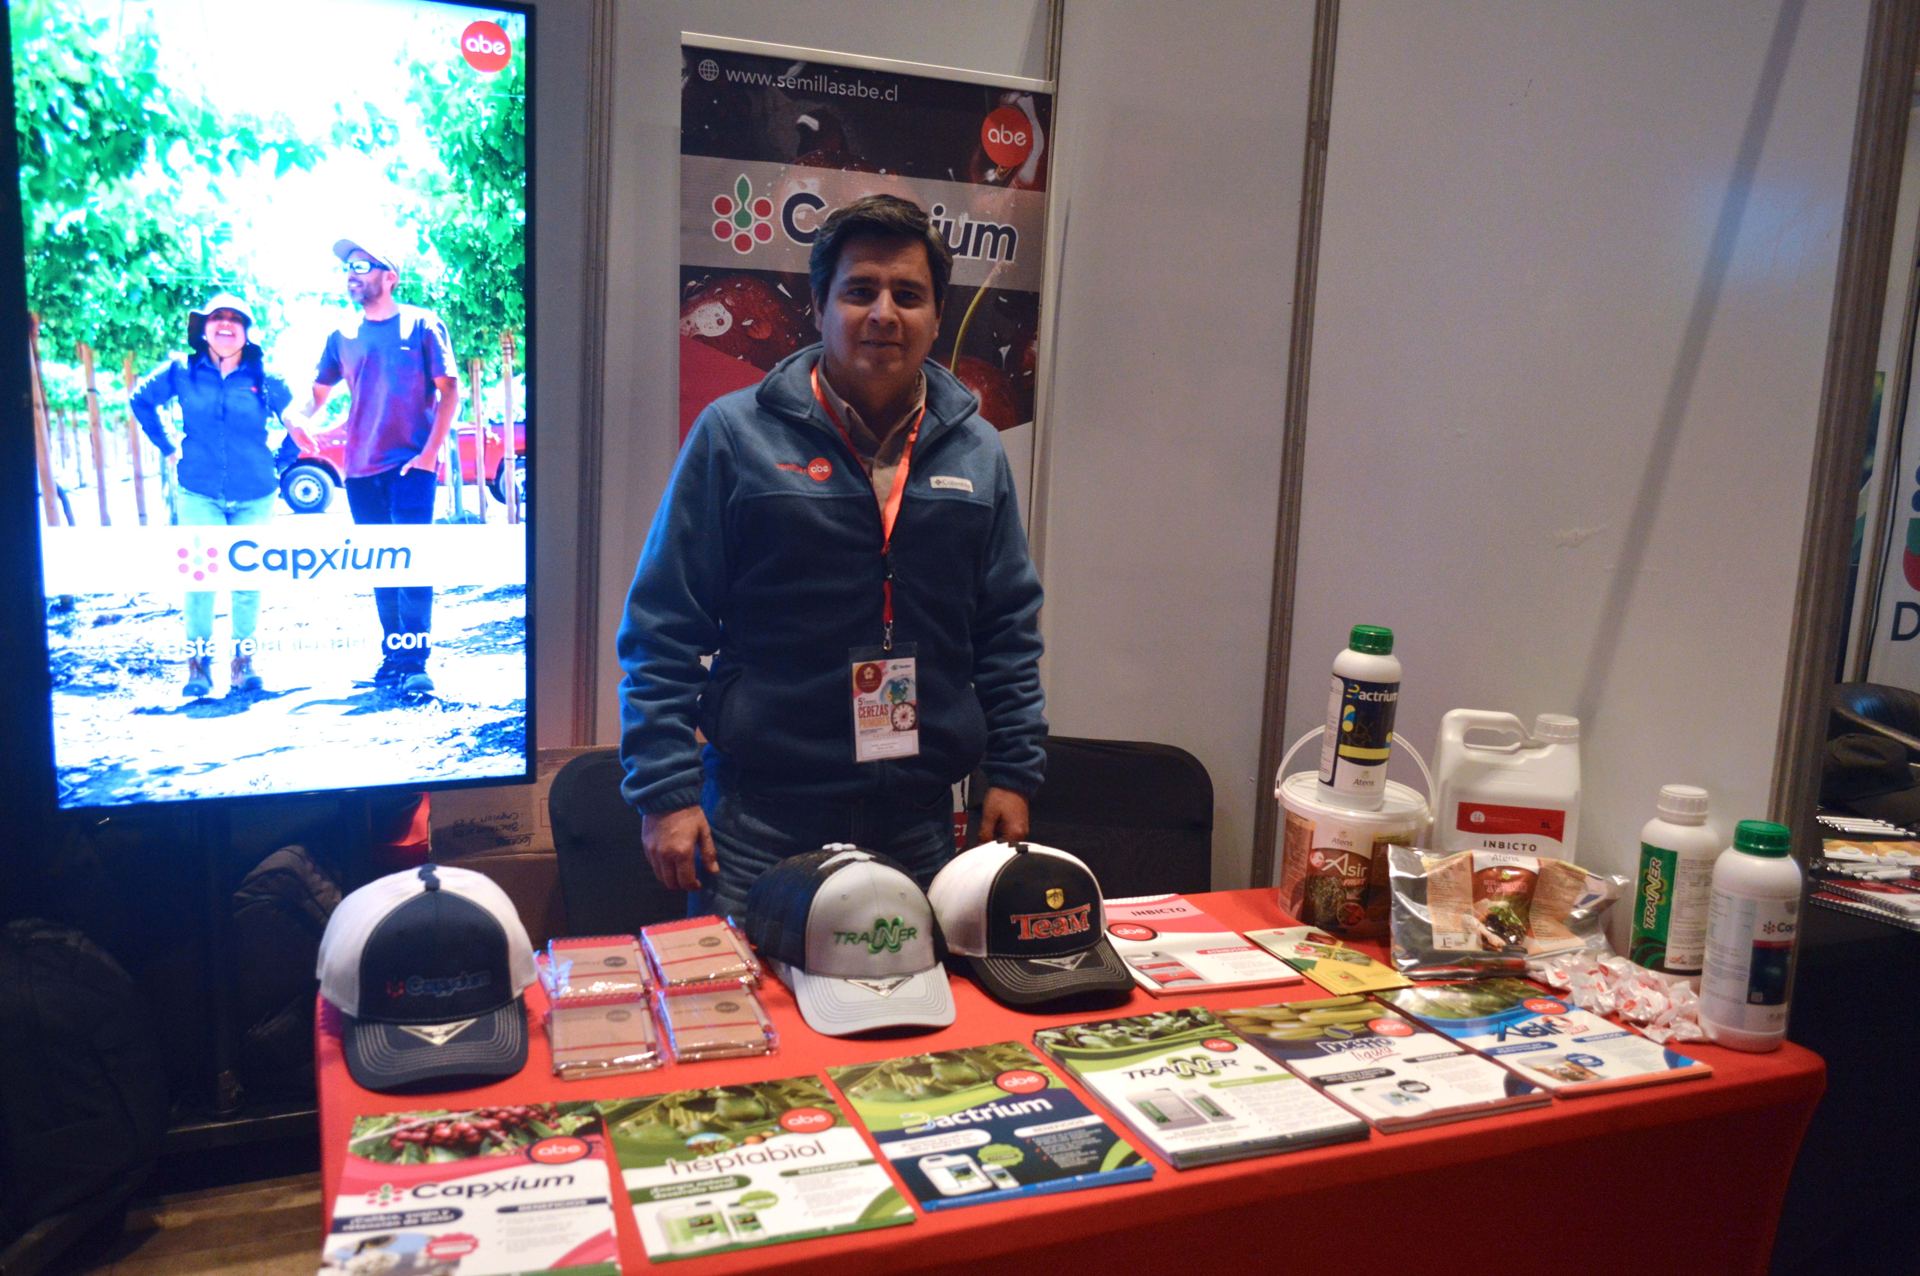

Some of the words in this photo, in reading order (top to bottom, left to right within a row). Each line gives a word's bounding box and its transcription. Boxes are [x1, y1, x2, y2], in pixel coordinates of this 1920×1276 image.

[465, 33, 507, 57] abe
[725, 69, 898, 102] www.semillasabe.cl
[986, 124, 1027, 147] abe
[228, 539, 412, 580] Capxium
[1483, 840, 1537, 852] INBICTO
[1643, 858, 1664, 930] TRAINER
[1131, 906, 1187, 917] INBICTO
[833, 916, 918, 953] TRAINER
[1116, 927, 1147, 936] abe
[1122, 1055, 1239, 1080] TRAINER
[1003, 1076, 1039, 1089] abe
[787, 1111, 827, 1126] abe
[899, 1097, 1053, 1134] Bactrium
[537, 1143, 582, 1157] abe
[668, 1140, 827, 1175] heptabiol
[411, 1173, 575, 1199] Capxium
